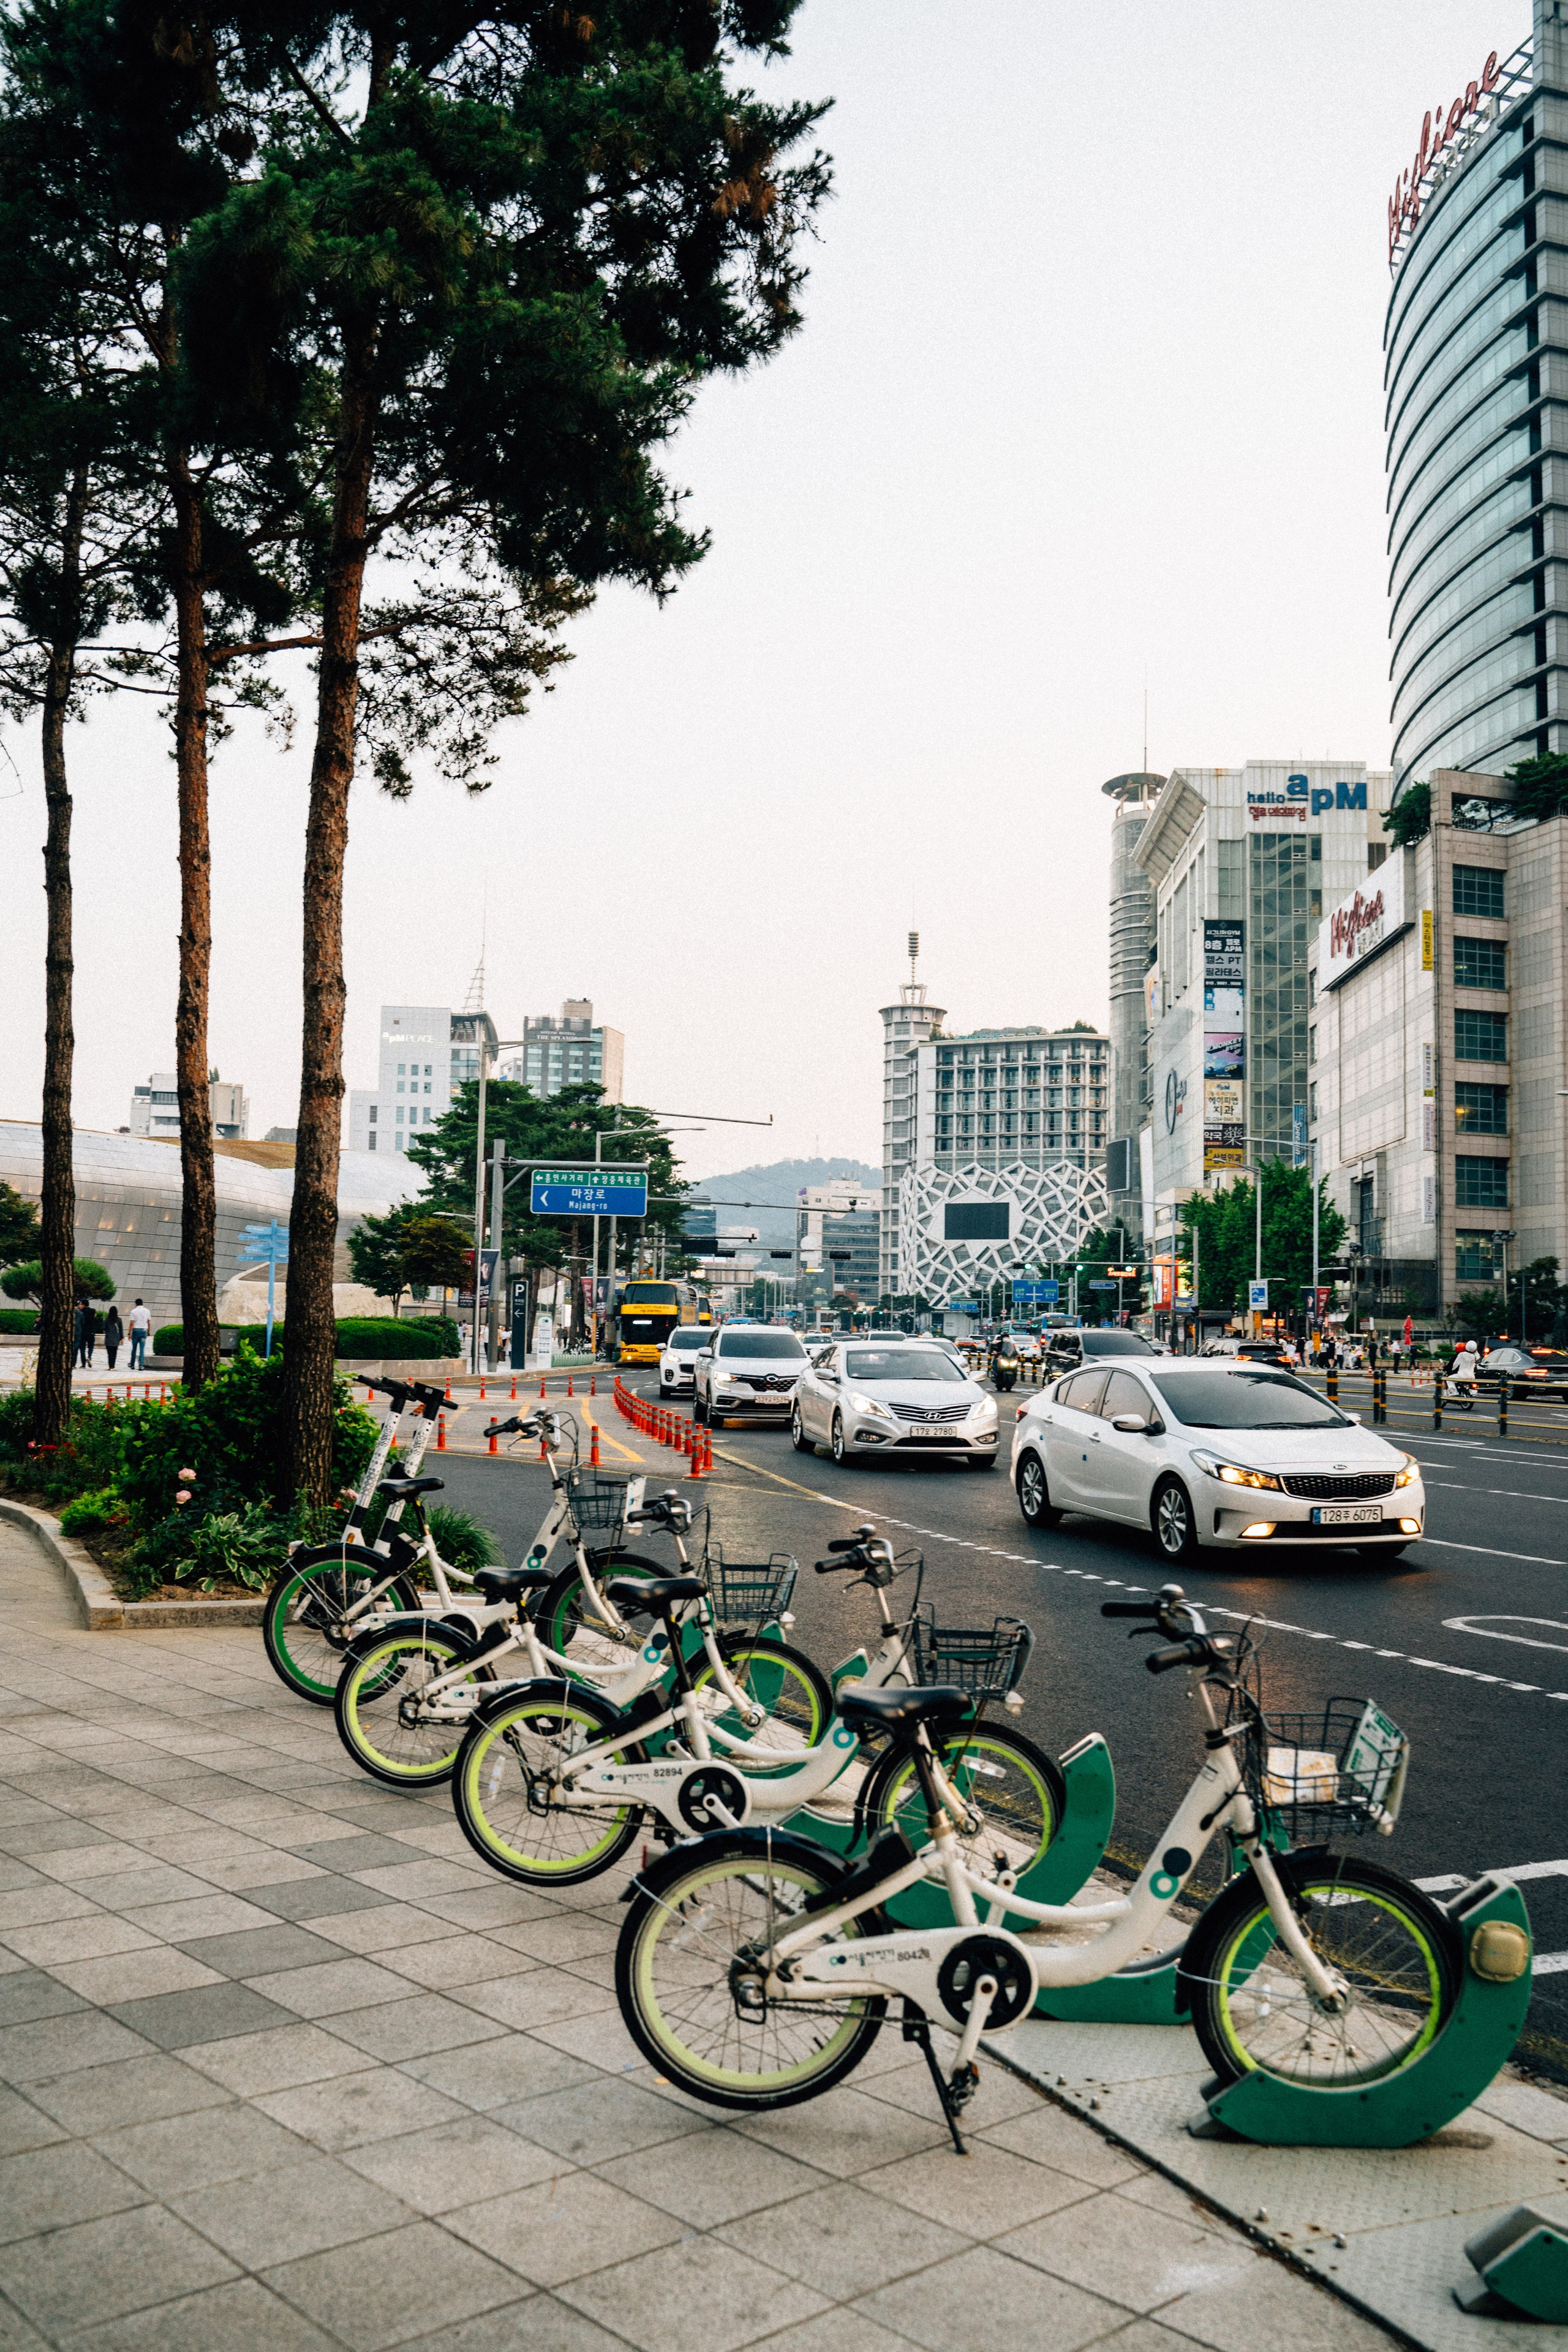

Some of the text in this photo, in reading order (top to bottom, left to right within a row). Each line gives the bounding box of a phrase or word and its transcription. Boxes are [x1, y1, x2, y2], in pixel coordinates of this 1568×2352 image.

[1247, 774, 1367, 815] hello apM
[1204, 940, 1223, 951] 8층
[1205, 956, 1224, 964] 헬스
[1205, 968, 1242, 976] 필라테스
[405, 1034, 435, 1042] PLACE
[1204, 1131, 1222, 1140] 약국
[545, 1174, 584, 1183] 흥인사거리
[601, 1175, 641, 1185] 장충체육관
[571, 1188, 605, 1201] 마장로
[568, 1200, 608, 1211] Majang-ro
[515, 1284, 525, 1297] P
[1322, 1509, 1379, 1522] 128주 6075
[654, 1768, 683, 1777] 82894
